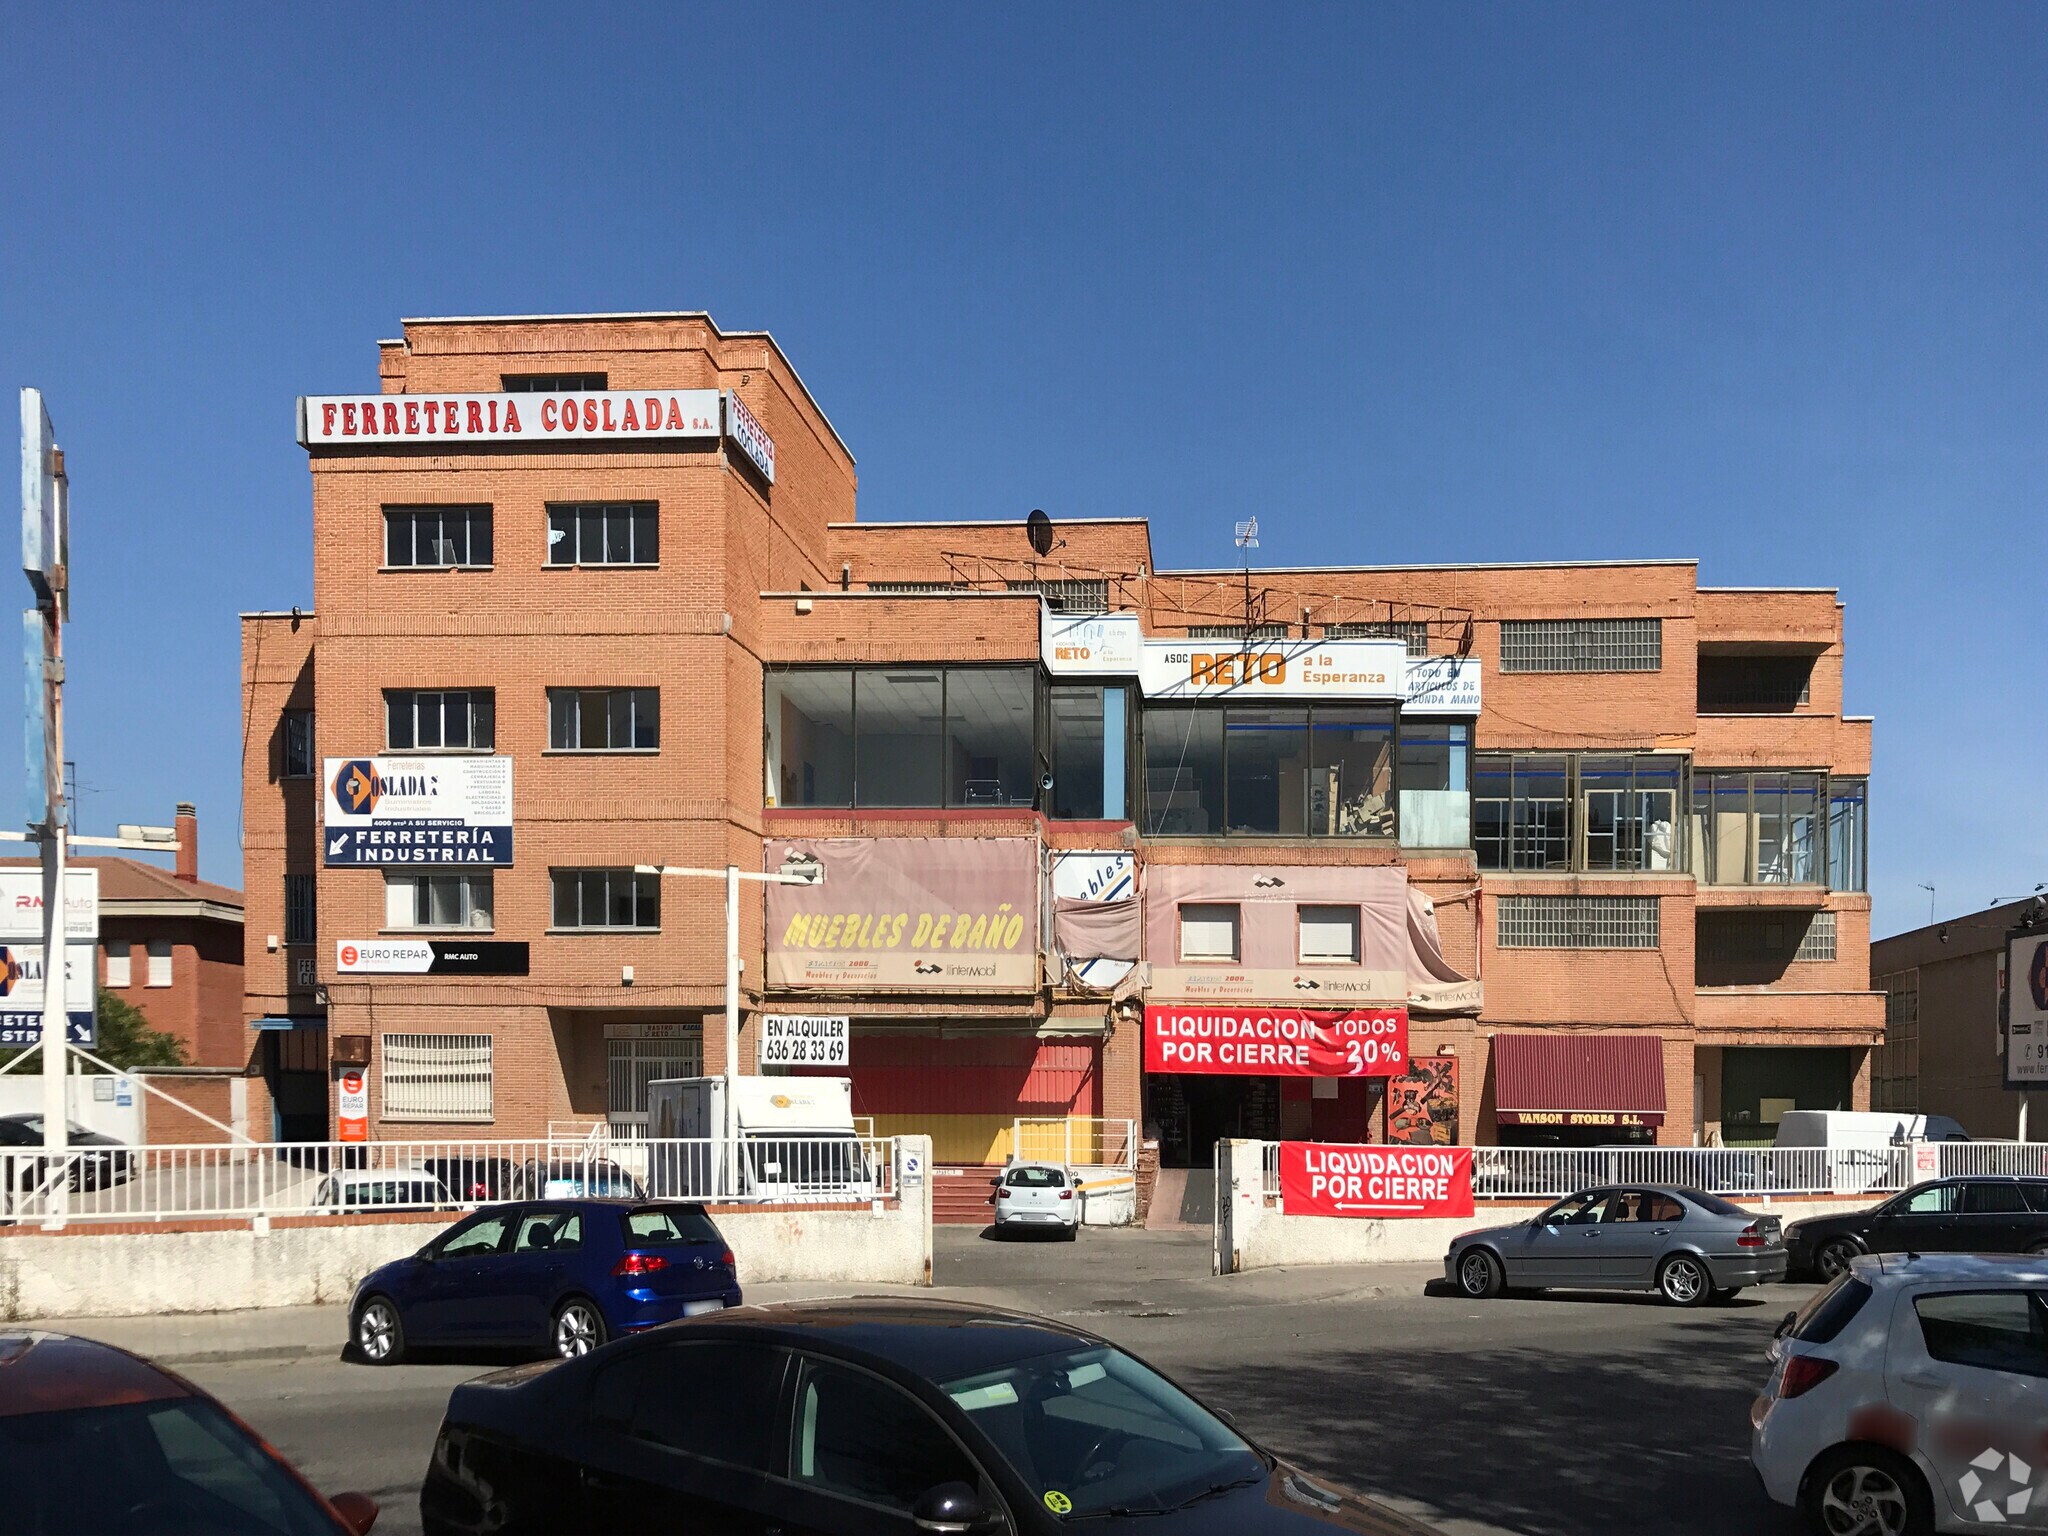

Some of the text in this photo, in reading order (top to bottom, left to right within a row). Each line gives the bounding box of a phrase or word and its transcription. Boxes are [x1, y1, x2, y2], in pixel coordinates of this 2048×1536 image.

[322, 397, 714, 436] FERRETERIA COSLADA S.A.
[733, 395, 773, 461] FERRETERIA
[737, 423, 770, 477] COSLADA
[1055, 647, 1091, 660] RETO
[1303, 654, 1333, 666] a la
[1164, 653, 1286, 685] ASOC. RETO
[1303, 670, 1385, 685] Esperanza
[1417, 668, 1441, 677] TODO
[1408, 681, 1475, 691] ARTICULOS DE
[1403, 695, 1480, 704] EGUNDA MANO
[356, 827, 494, 844] FERRETERÍA
[356, 848, 494, 861] INDUSTRIAL
[783, 903, 1024, 950] MUEBLES DE BAÑO
[360, 950, 390, 959] EURO
[393, 950, 428, 959] REPAR
[805, 971, 833, 979] Muebles
[767, 1020, 844, 1038] EN ALQUILER
[1156, 1016, 1397, 1040] LIQUIDACION TODOS
[767, 1041, 844, 1061] 636 28 33 69
[1162, 1042, 1213, 1062] POR
[1219, 1043, 1310, 1065] CIERRE
[1518, 1113, 1644, 1125] VANSON STORES S.L.
[1306, 1150, 1454, 1176] LIQUIDACION
[1312, 1176, 1449, 1200] POR CIERRE
